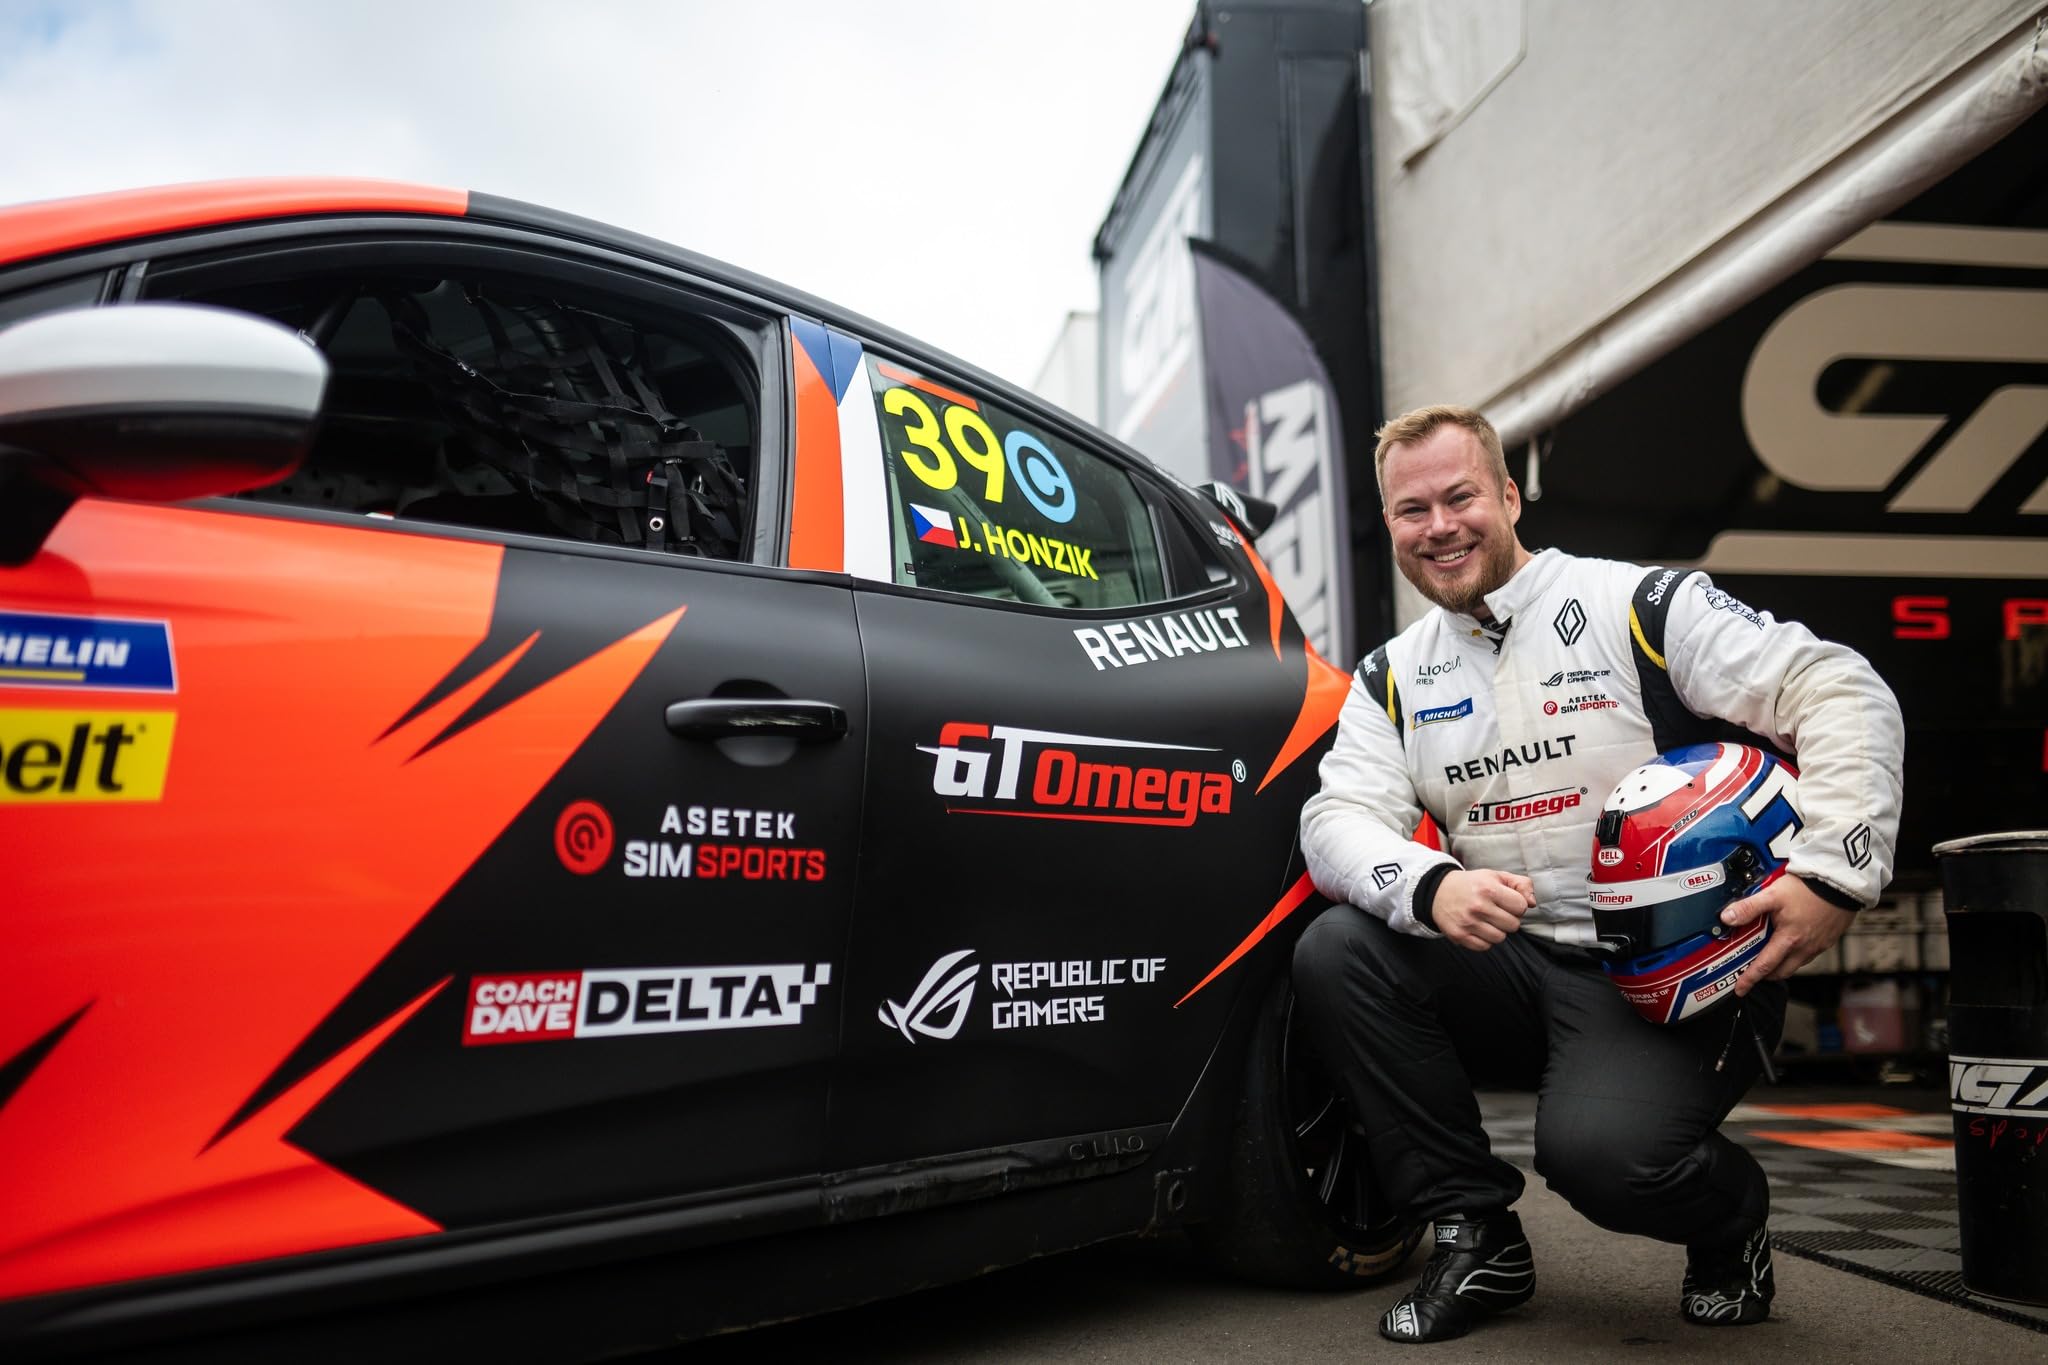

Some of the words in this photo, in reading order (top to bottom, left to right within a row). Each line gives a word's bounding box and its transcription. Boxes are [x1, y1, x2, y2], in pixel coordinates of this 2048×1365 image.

[883, 388, 1005, 503] 39
[958, 516, 981, 552] J.
[981, 522, 1099, 580] HONZIK
[1647, 569, 1679, 606] Sabelt
[1073, 607, 1249, 670] RENAULT
[1424, 703, 1469, 722] MICHELIN
[1560, 705, 1578, 714] SIM
[1580, 701, 1618, 711] SPORTS
[1568, 694, 1607, 704] ASETEK
[0, 721, 135, 794] elt
[1444, 735, 1577, 785] RENAULT
[661, 806, 795, 840] ASETEK
[624, 841, 692, 878] SIM
[696, 844, 827, 882] SPORTS
[1600, 851, 1620, 860] BELL
[1687, 873, 1714, 887] BELL
[475, 980, 577, 1006] COACH
[991, 960, 1129, 997] REPUBLIC
[1131, 958, 1167, 983] OF
[470, 1003, 572, 1035] DAVE
[584, 975, 783, 1027] DELTA
[992, 996, 1105, 1029] GAMERS
[1068, 1135, 1145, 1160] CLIO
[1436, 1228, 1458, 1241] OMP
